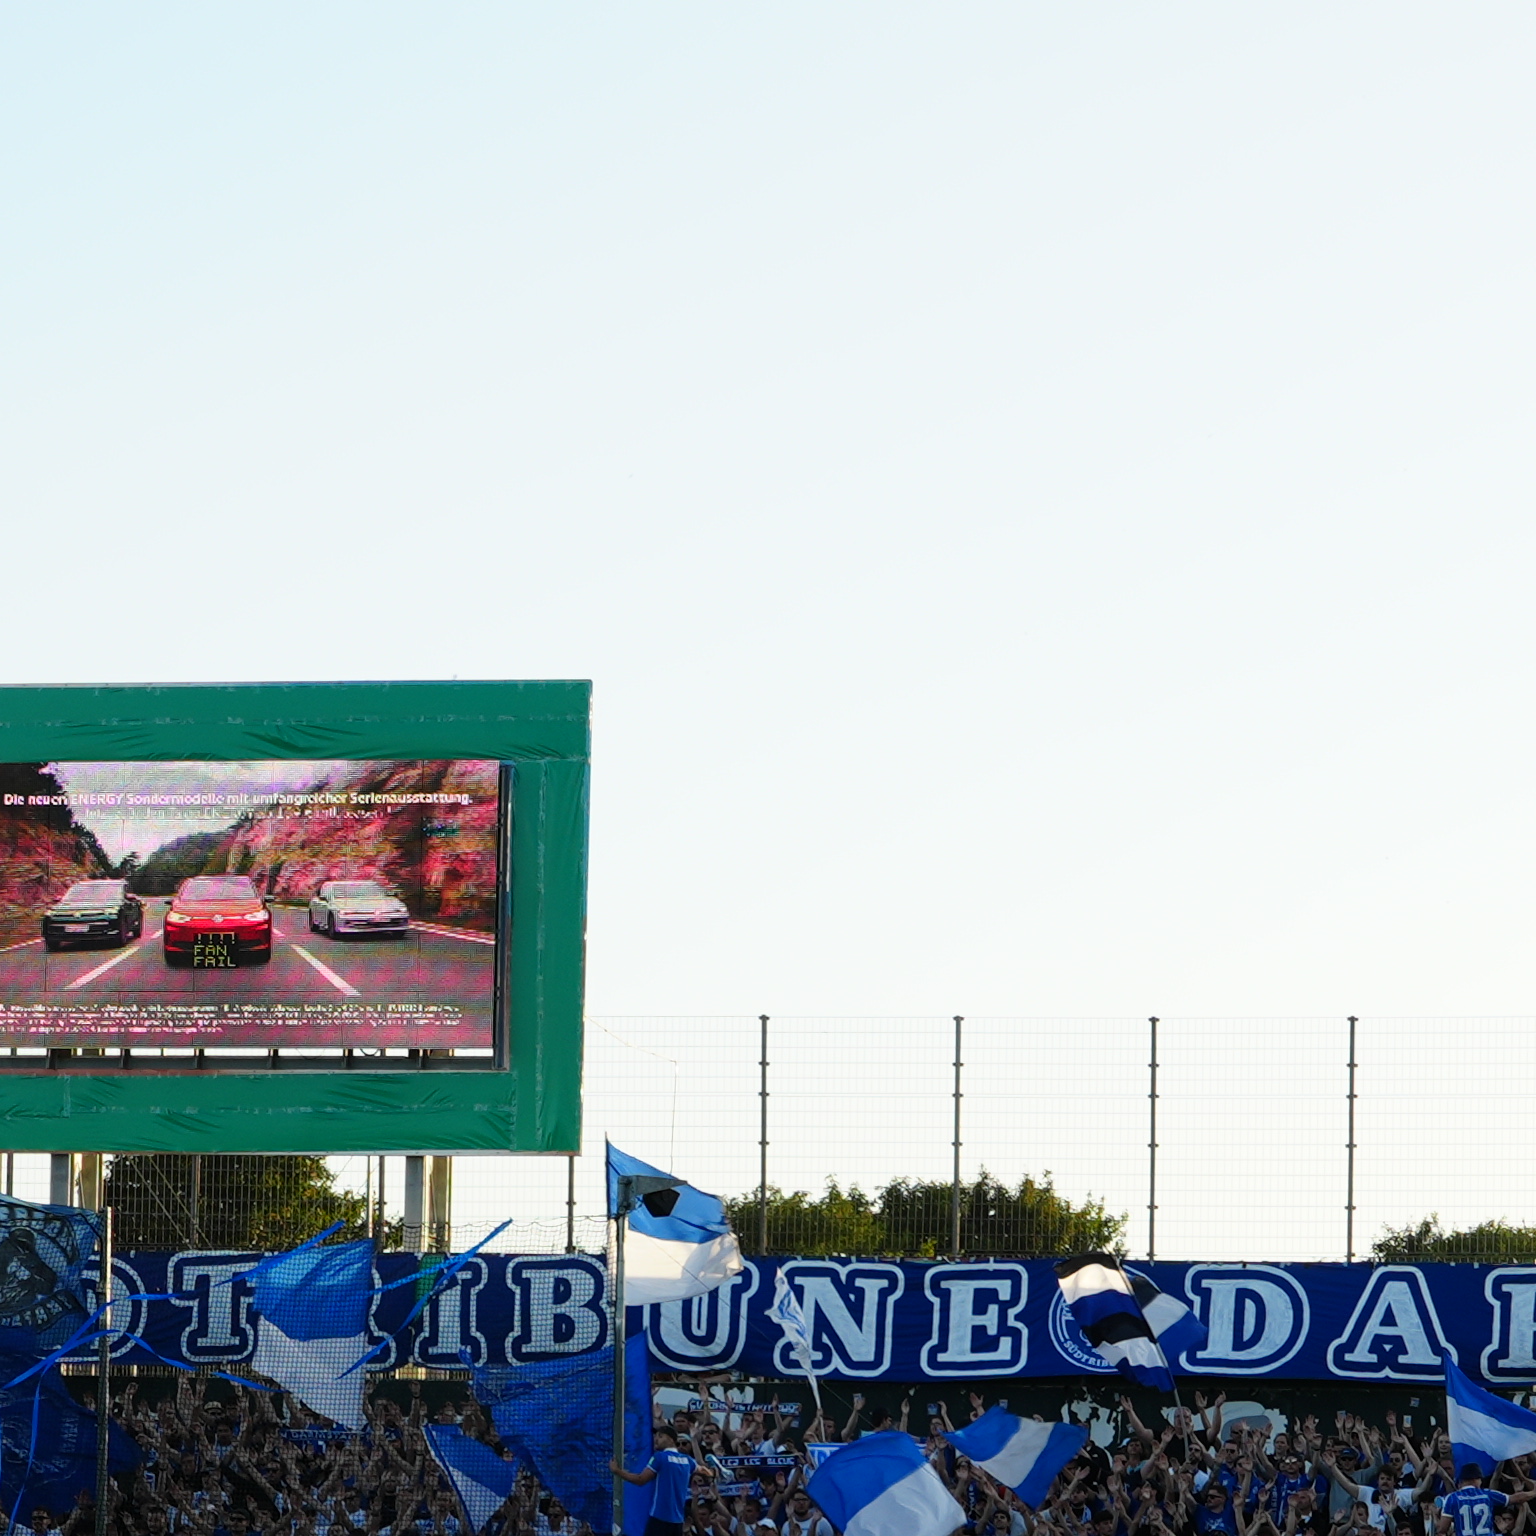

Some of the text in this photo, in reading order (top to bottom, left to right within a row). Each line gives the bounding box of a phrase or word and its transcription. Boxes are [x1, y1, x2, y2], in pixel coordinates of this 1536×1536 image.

[71, 793, 125, 806] ENERGY
[126, 793, 224, 806] Sondermodelle
[193, 945, 227, 956] FAN
[193, 956, 236, 968] FAIL
